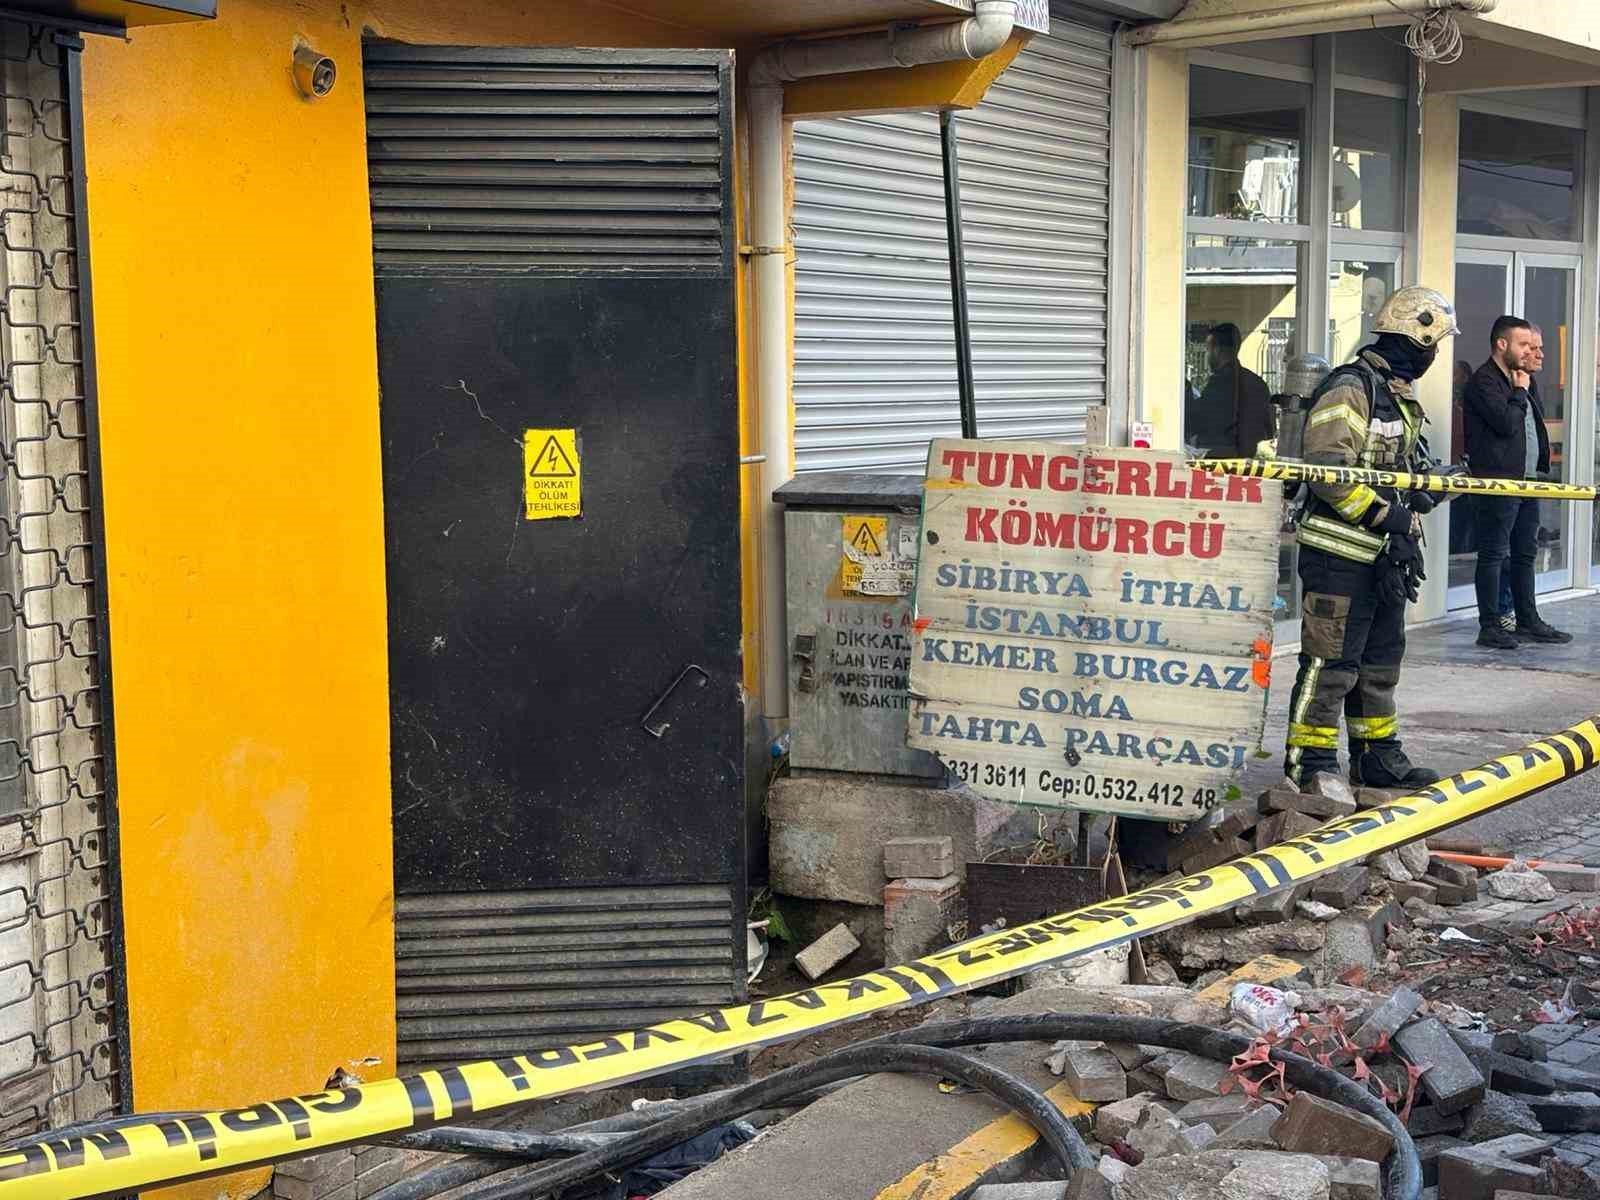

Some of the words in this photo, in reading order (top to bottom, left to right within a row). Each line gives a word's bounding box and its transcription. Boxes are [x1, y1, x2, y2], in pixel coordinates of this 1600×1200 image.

[539, 490, 568, 500] ÖLÜM
[964, 499, 1225, 559] KÖMÜRCÜ
[936, 558, 1093, 598] SİBİRYA
[1119, 571, 1250, 612] İTHAL
[964, 600, 1169, 646] İSTANBUL
[869, 655, 888, 669] VE
[921, 638, 1058, 673] KEMER
[1073, 652, 1249, 692] BURGAZ
[1018, 687, 1134, 721] SOMA
[918, 711, 1047, 748] TAHTA
[1064, 726, 1247, 770] PARÇASI
[983, 763, 1028, 788] 3611
